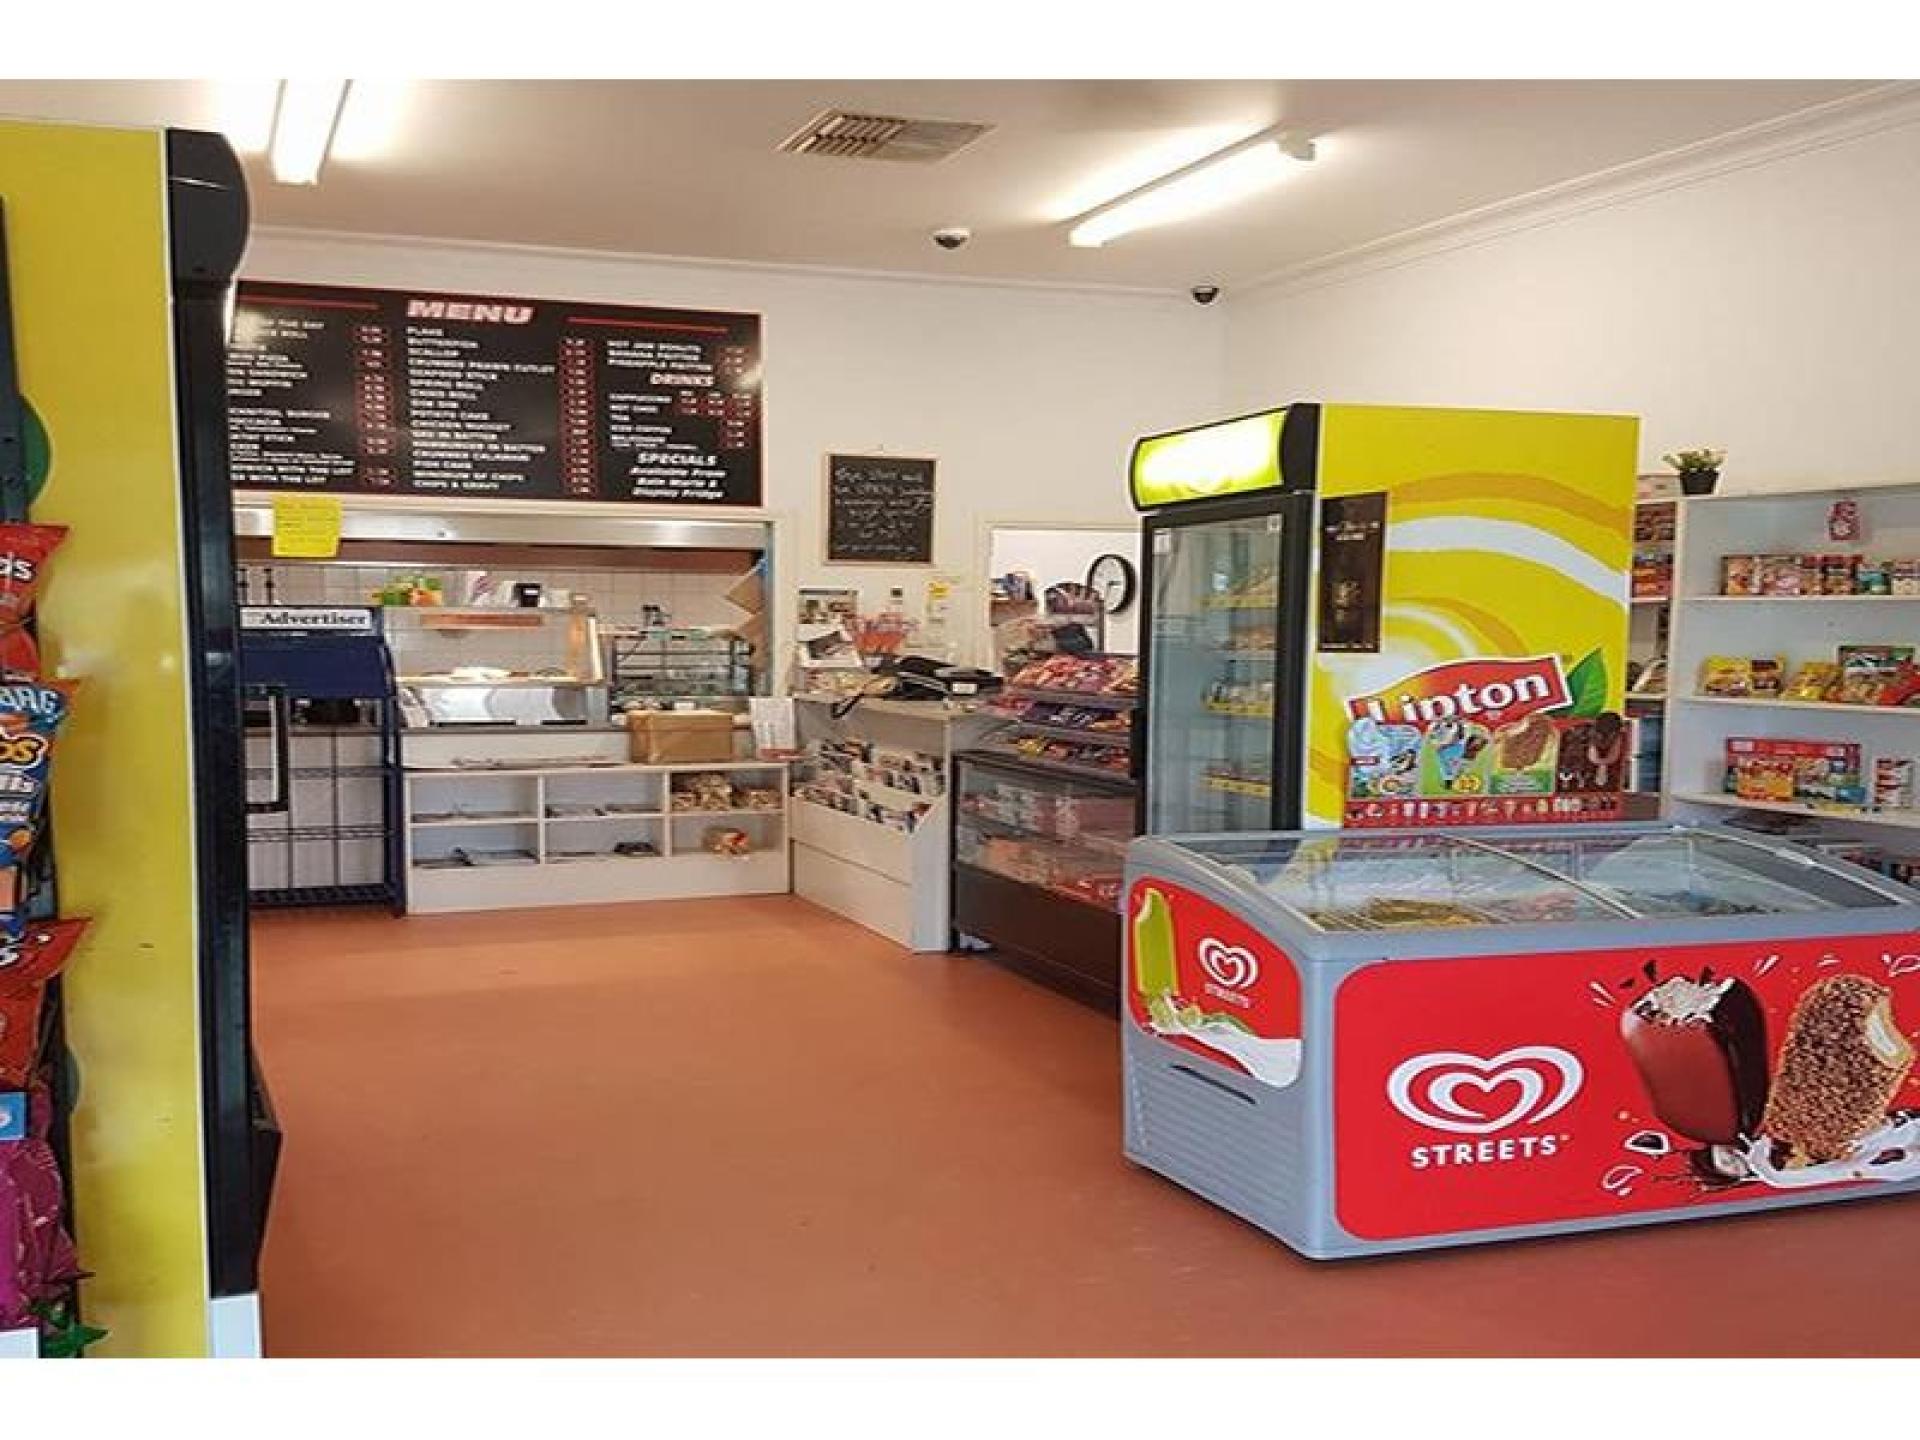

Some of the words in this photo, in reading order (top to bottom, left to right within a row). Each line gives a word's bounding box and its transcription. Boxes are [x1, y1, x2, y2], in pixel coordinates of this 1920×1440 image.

[406, 300, 535, 324] MENU
[649, 371, 715, 386] DRINKS
[636, 451, 718, 467] SPECIALS
[261, 610, 366, 625] Advertiser
[1366, 674, 1550, 722] Lipton
[1411, 1134, 1557, 1170] STREETS
